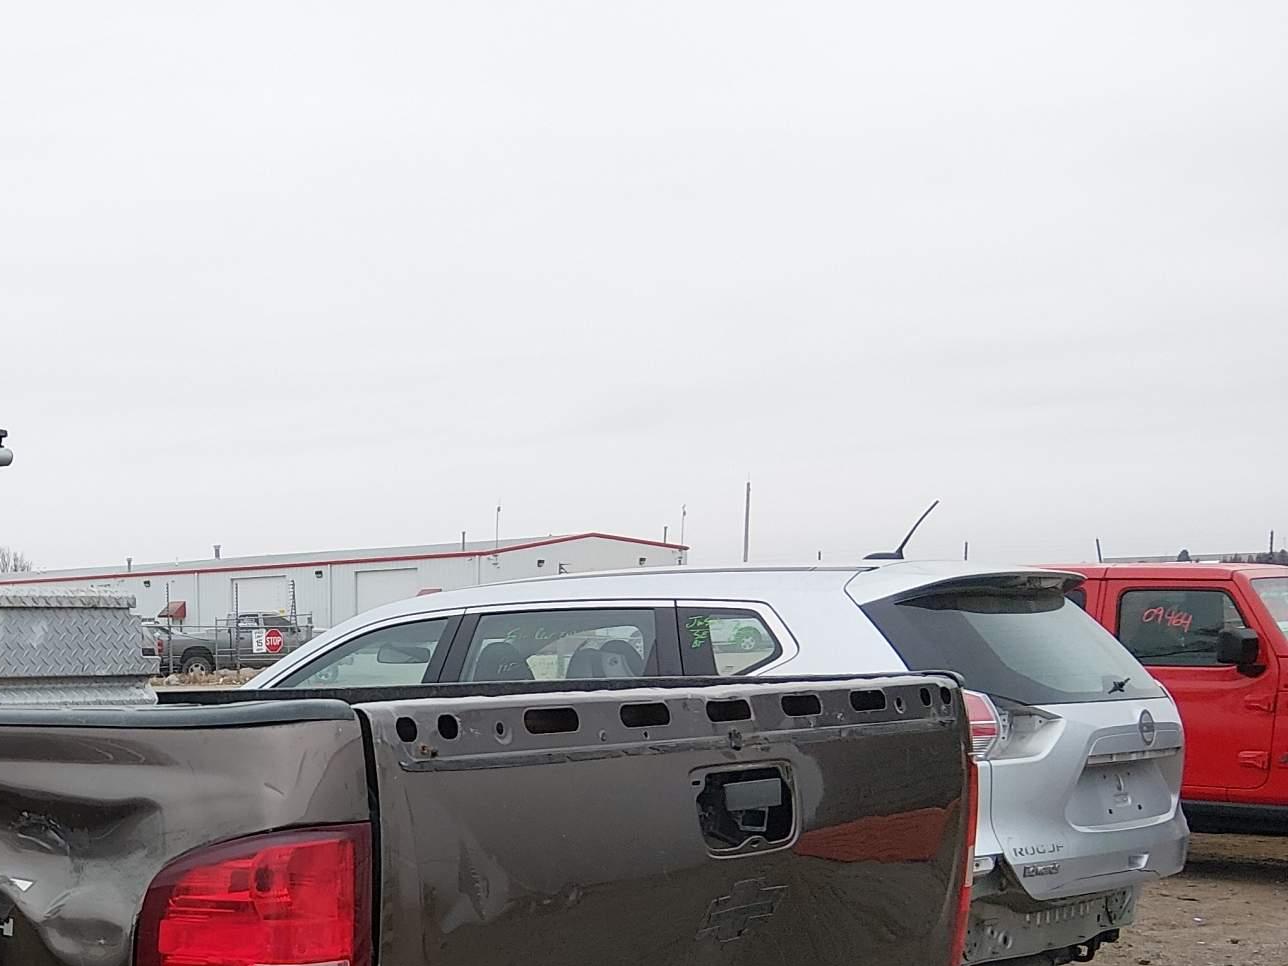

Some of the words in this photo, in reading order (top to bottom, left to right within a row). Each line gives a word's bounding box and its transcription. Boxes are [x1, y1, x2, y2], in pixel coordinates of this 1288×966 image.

[1142, 606, 1193, 633] 09464
[256, 639, 263, 647] 15
[266, 637, 281, 646] STOP
